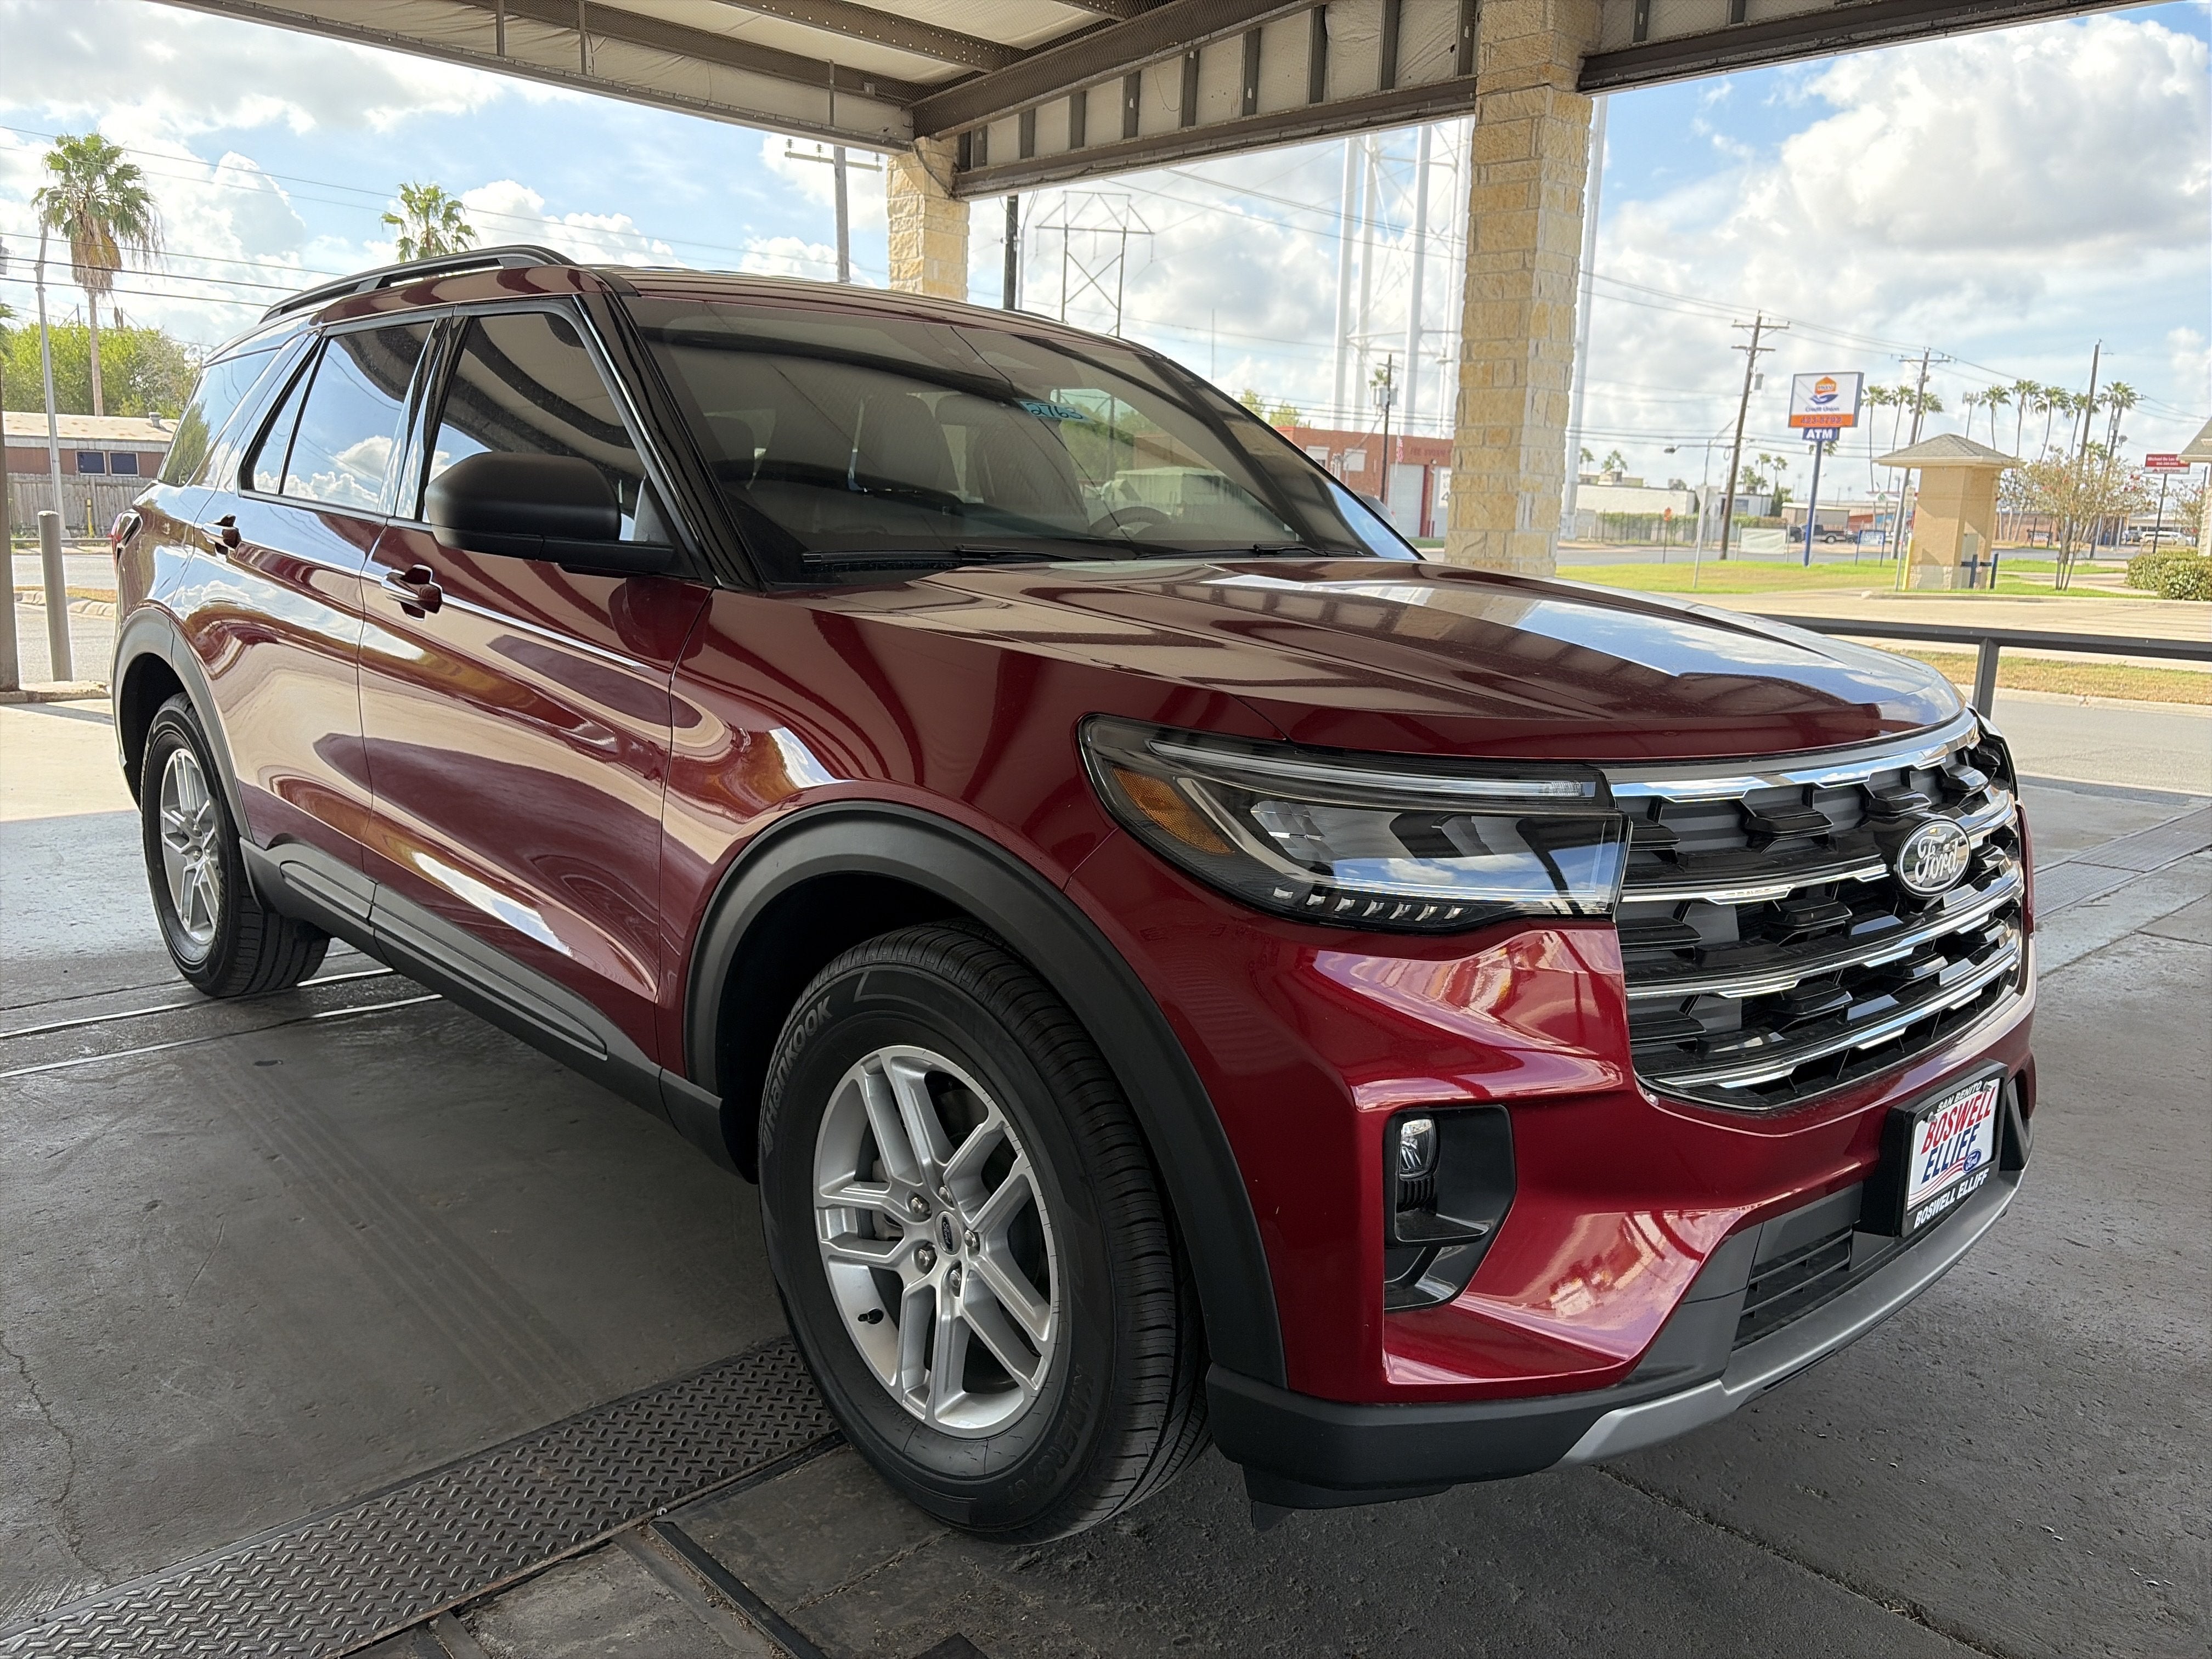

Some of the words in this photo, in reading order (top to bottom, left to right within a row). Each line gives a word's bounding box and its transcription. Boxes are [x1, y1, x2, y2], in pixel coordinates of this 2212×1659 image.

[1026, 403, 1084, 420] 2763
[1806, 428, 1833, 439] ATM
[1915, 833, 1960, 884] Ford
[1937, 1096, 1955, 1112] SAN
[1955, 1080, 1983, 1102] BENITO
[1921, 1086, 1997, 1155] BOSWELL
[1921, 1121, 1981, 1184] ELLIFF
[1966, 1152, 1979, 1169] Ford
[1914, 1188, 1956, 1229] BOSWELL
[1956, 1167, 1990, 1200] ELLIFF
[943, 1221, 951, 1245] Ford
